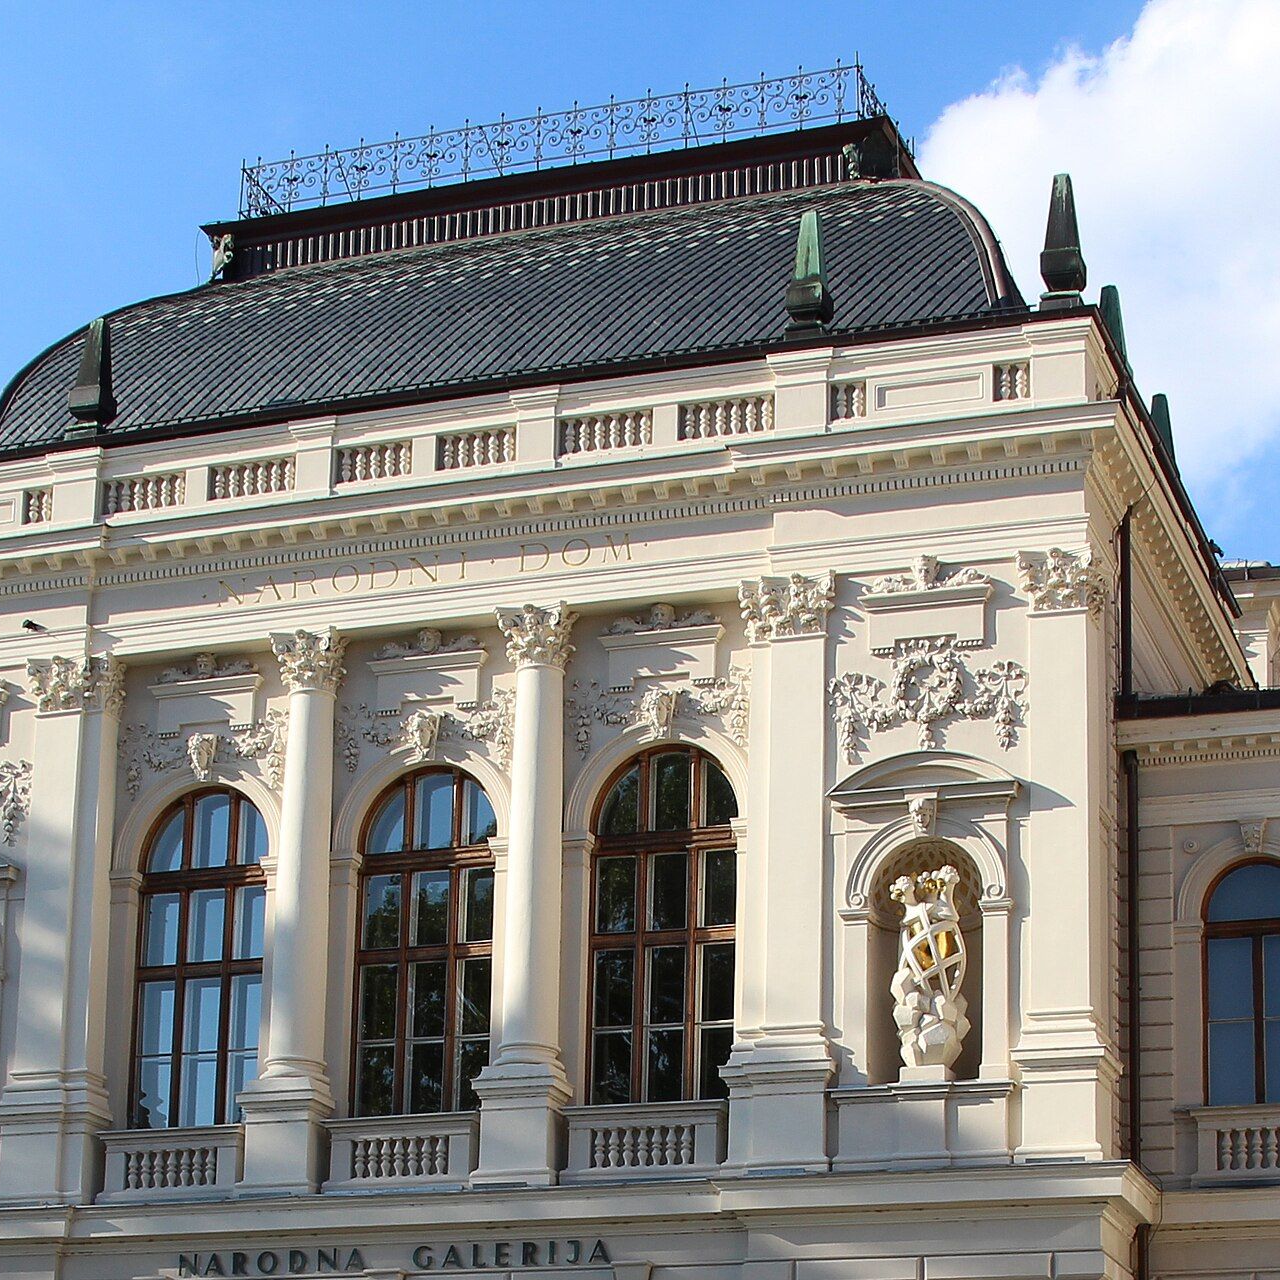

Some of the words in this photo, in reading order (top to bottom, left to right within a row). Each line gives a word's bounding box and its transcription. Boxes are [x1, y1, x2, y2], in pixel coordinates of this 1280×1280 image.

[218, 551, 468, 608] NARODNI
[519, 534, 634, 573] DOM
[178, 1248, 367, 1276] NARODNA
[412, 1239, 612, 1270] GALERIJA
